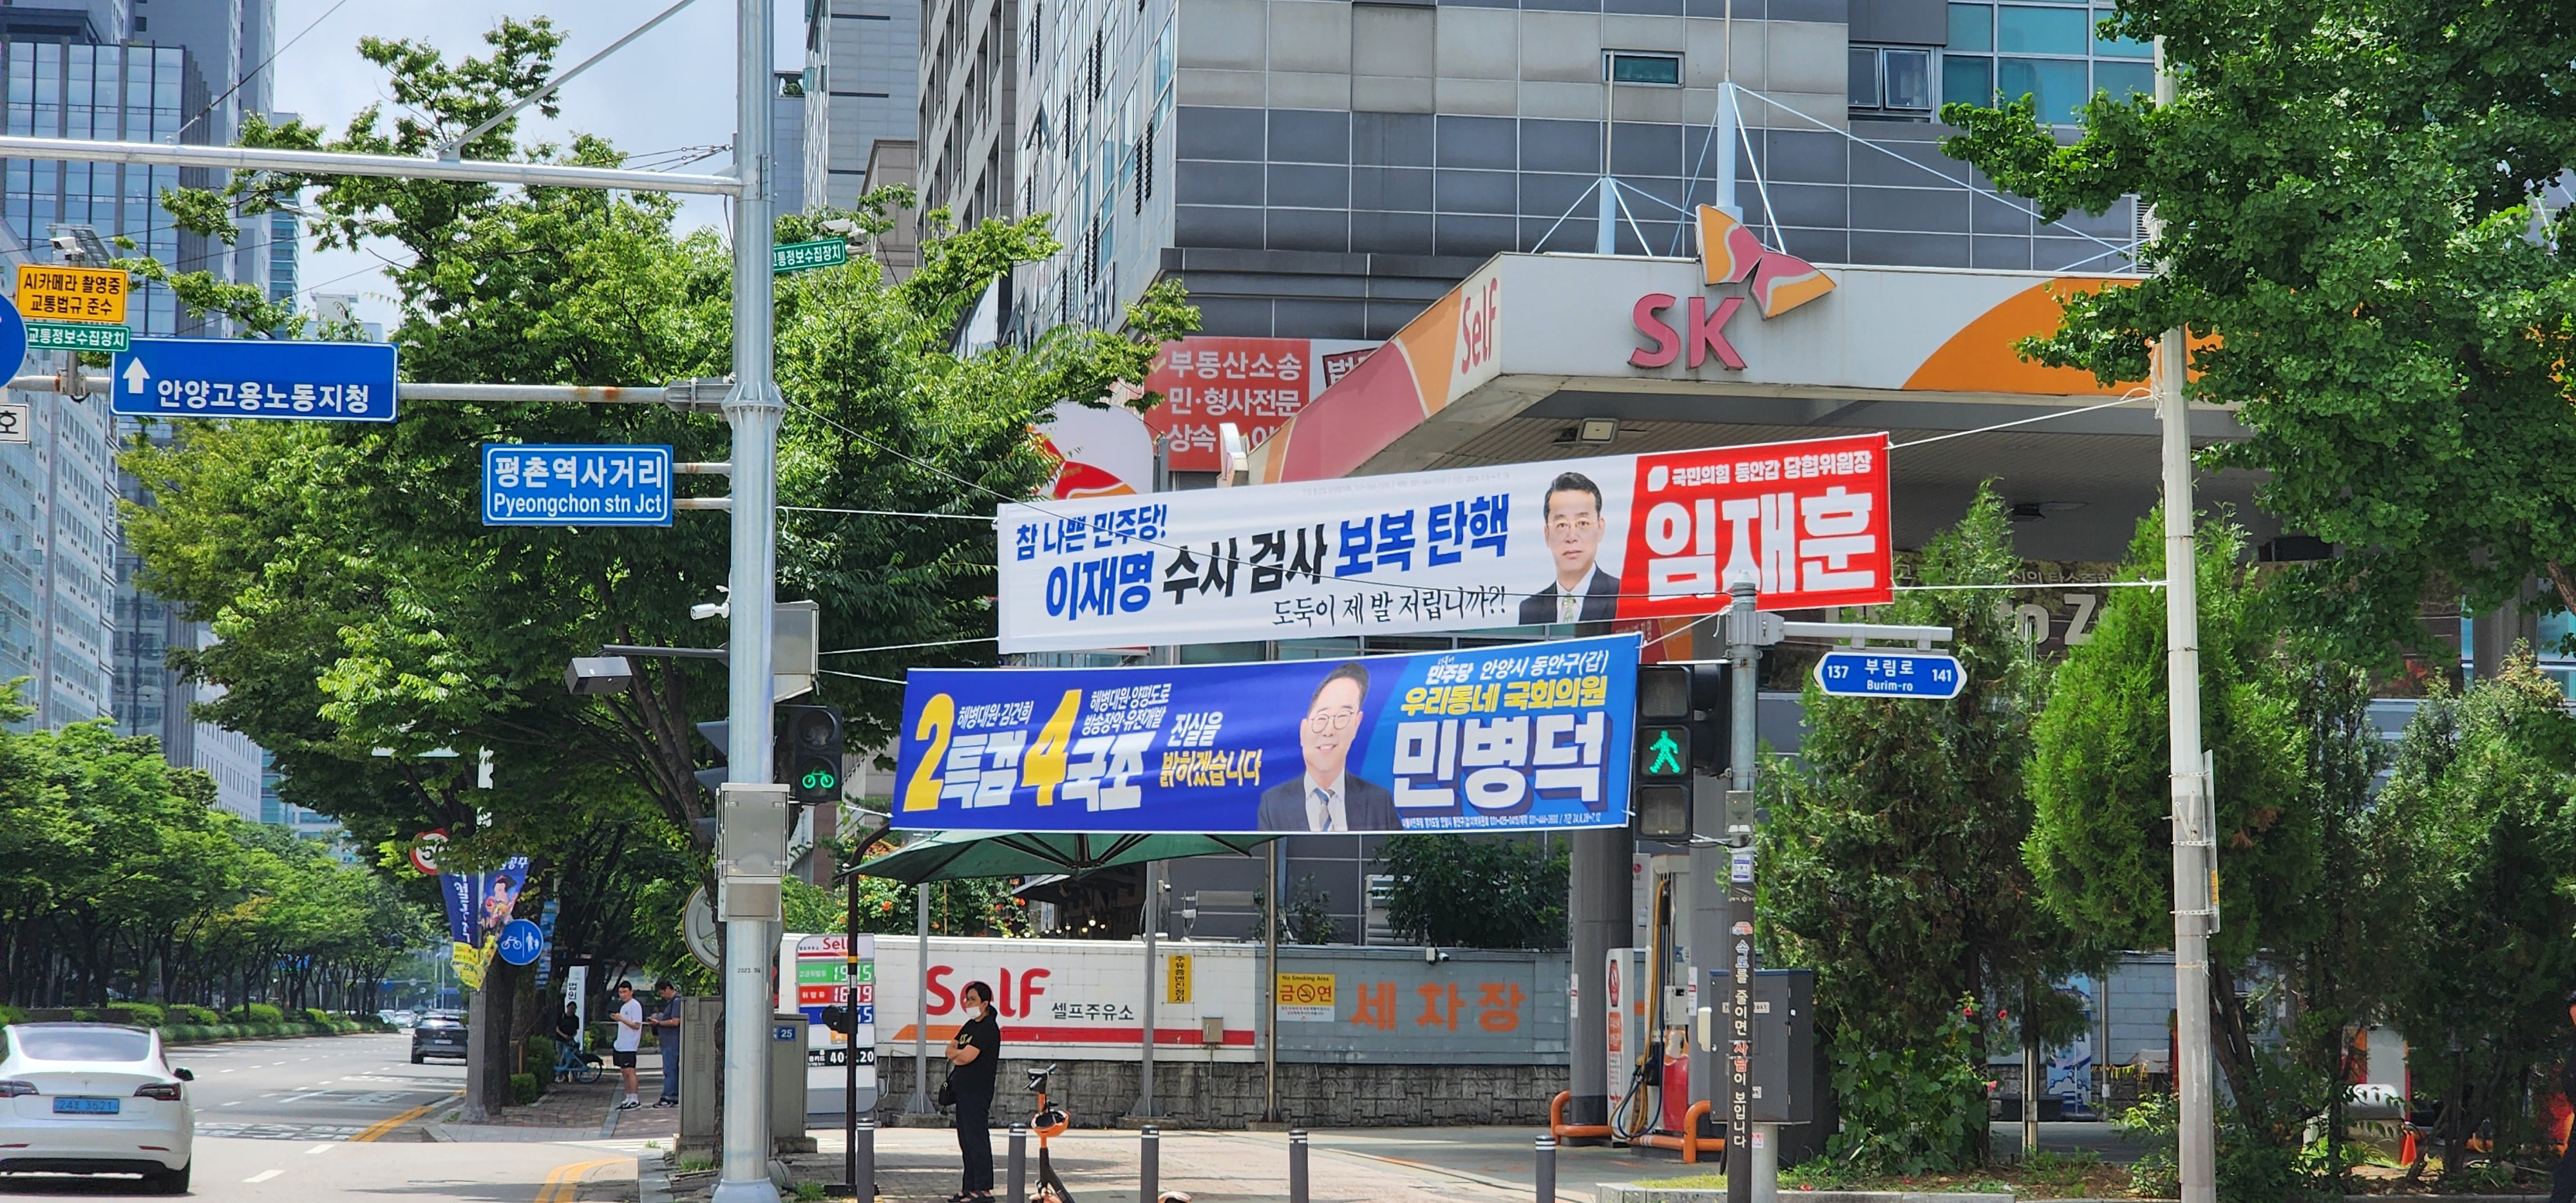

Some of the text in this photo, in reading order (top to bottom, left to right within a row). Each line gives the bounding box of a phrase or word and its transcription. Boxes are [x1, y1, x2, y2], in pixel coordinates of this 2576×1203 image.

[24, 273, 120, 295] AI카메라 촬영중
[30, 294, 112, 316] 교통법규 준수
[28, 327, 124, 346] 교통정보수집장치
[1461, 277, 1498, 375] Self
[1627, 292, 1748, 372] SK
[1169, 350, 1302, 381] 부동산소송
[157, 379, 369, 413] 안양고용노동지청
[1170, 387, 1301, 417] 민·형사전문
[1168, 424, 1217, 453] 상속
[495, 455, 662, 488] 평촌역사거리
[1672, 450, 1872, 487] 국민의힘 동안갑 당협위원장
[494, 493, 661, 517] Pyeongchon stn Jct
[1016, 504, 1168, 562] 참 나쁜 민주당!
[1645, 486, 1875, 602] 임재훈
[1046, 493, 1510, 621] 이재명 수사 검사 보복 탄핵
[1273, 585, 1506, 627] 도둑이 제 발 저립니까?!
[1425, 650, 1609, 685] 민주당 안양시 동안구(갑)
[1827, 665, 1849, 679] 137
[1864, 659, 1914, 677] 부림로
[1932, 668, 1951, 682] 141
[1400, 675, 1607, 717] 우리동네 국회의원
[1867, 679, 1913, 692] Burim-ro
[1166, 710, 1224, 748] 진실을
[1159, 748, 1263, 788] 밝히겠습니다
[1392, 711, 1605, 810] 민병덕
[823, 938, 848, 950] Sel
[834, 965, 871, 981] 195
[1734, 940, 1750, 984] 속도를
[834, 986, 872, 1002] 169
[1052, 1002, 1134, 1021] 셀프주유소
[1734, 990, 1747, 1036] 줄이면
[781, 1029, 793, 1038] 25
[1733, 1092, 1747, 1148] 보입니다
